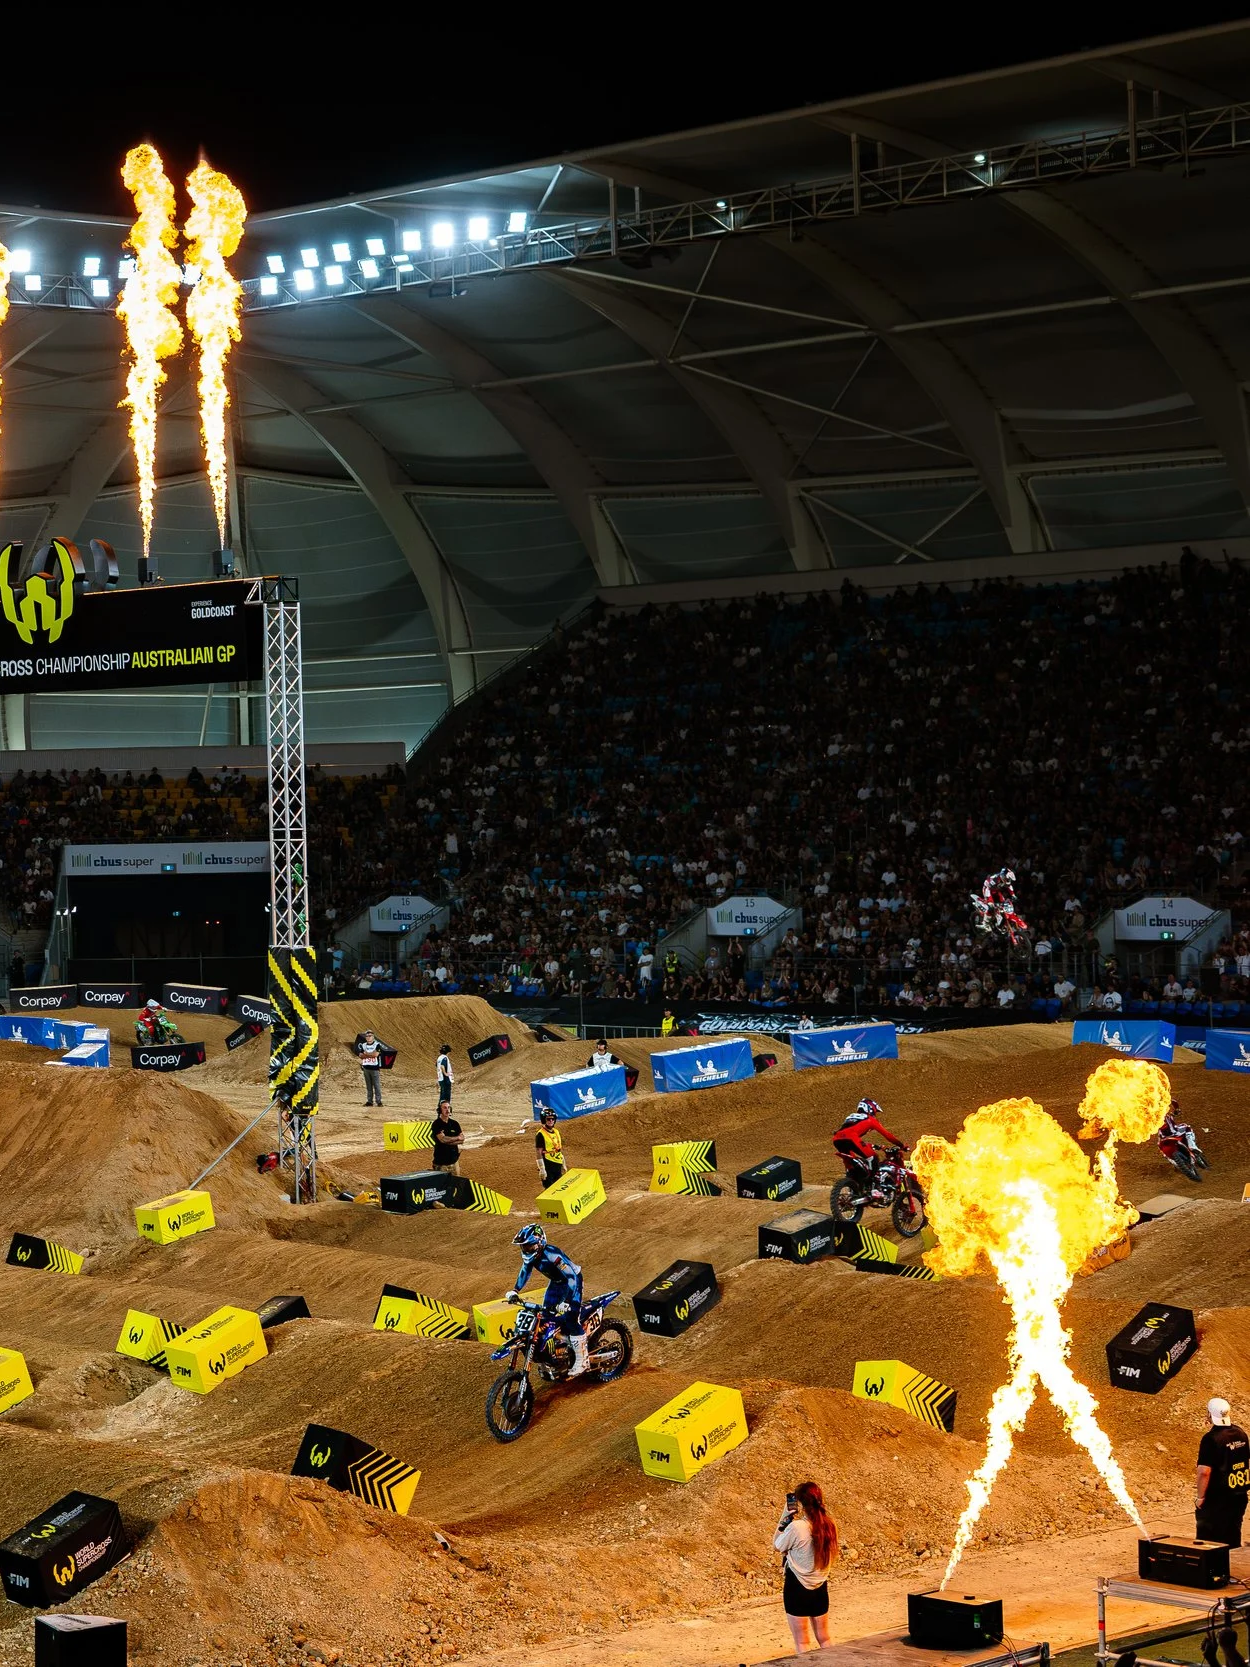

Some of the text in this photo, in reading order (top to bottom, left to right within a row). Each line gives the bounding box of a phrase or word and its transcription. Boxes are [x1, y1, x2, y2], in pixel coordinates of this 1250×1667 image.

[191, 605, 236, 619] GOLDCOAST
[36, 653, 130, 675] CHAMPIONSHIP
[132, 646, 213, 669] AUSTRALIAN
[216, 644, 236, 662] GP
[93, 855, 154, 868] cbus super
[204, 853, 266, 866] cbus super
[401, 898, 410, 906] 16
[745, 899, 755, 907] 15
[1161, 900, 1174, 909] 14
[393, 910, 412, 920] cbus
[735, 912, 758, 924] cbus
[1148, 914, 1178, 927] cbus
[19, 996, 62, 1008] Corpay
[85, 990, 125, 1004] Corpay
[170, 992, 207, 1008] Corpay
[241, 1004, 272, 1023] Corpay
[140, 1053, 181, 1067] Corpay
[473, 1047, 492, 1060] Corpay
[826, 1054, 868, 1063] MICHELIN
[692, 1072, 729, 1084] MICHELIN
[573, 1099, 607, 1112] MICHELIN
[385, 1191, 399, 1200] FIM
[545, 1211, 559, 1219] FIM
[142, 1223, 154, 1231] FIM
[764, 1243, 783, 1255] FIM
[518, 1313, 534, 1331] 38
[642, 1314, 661, 1324] FIM
[174, 1366, 191, 1378] FIM
[1116, 1365, 1141, 1379] FIM
[708, 1424, 724, 1439] WORLD
[709, 1421, 737, 1445] SUPERCROSS
[647, 1450, 670, 1464] FIM
[1232, 1461, 1246, 1471] CREW
[74, 1541, 95, 1560] WORLD
[76, 1536, 113, 1567] SUPERCROSS
[6, 1572, 30, 1588] FIM
